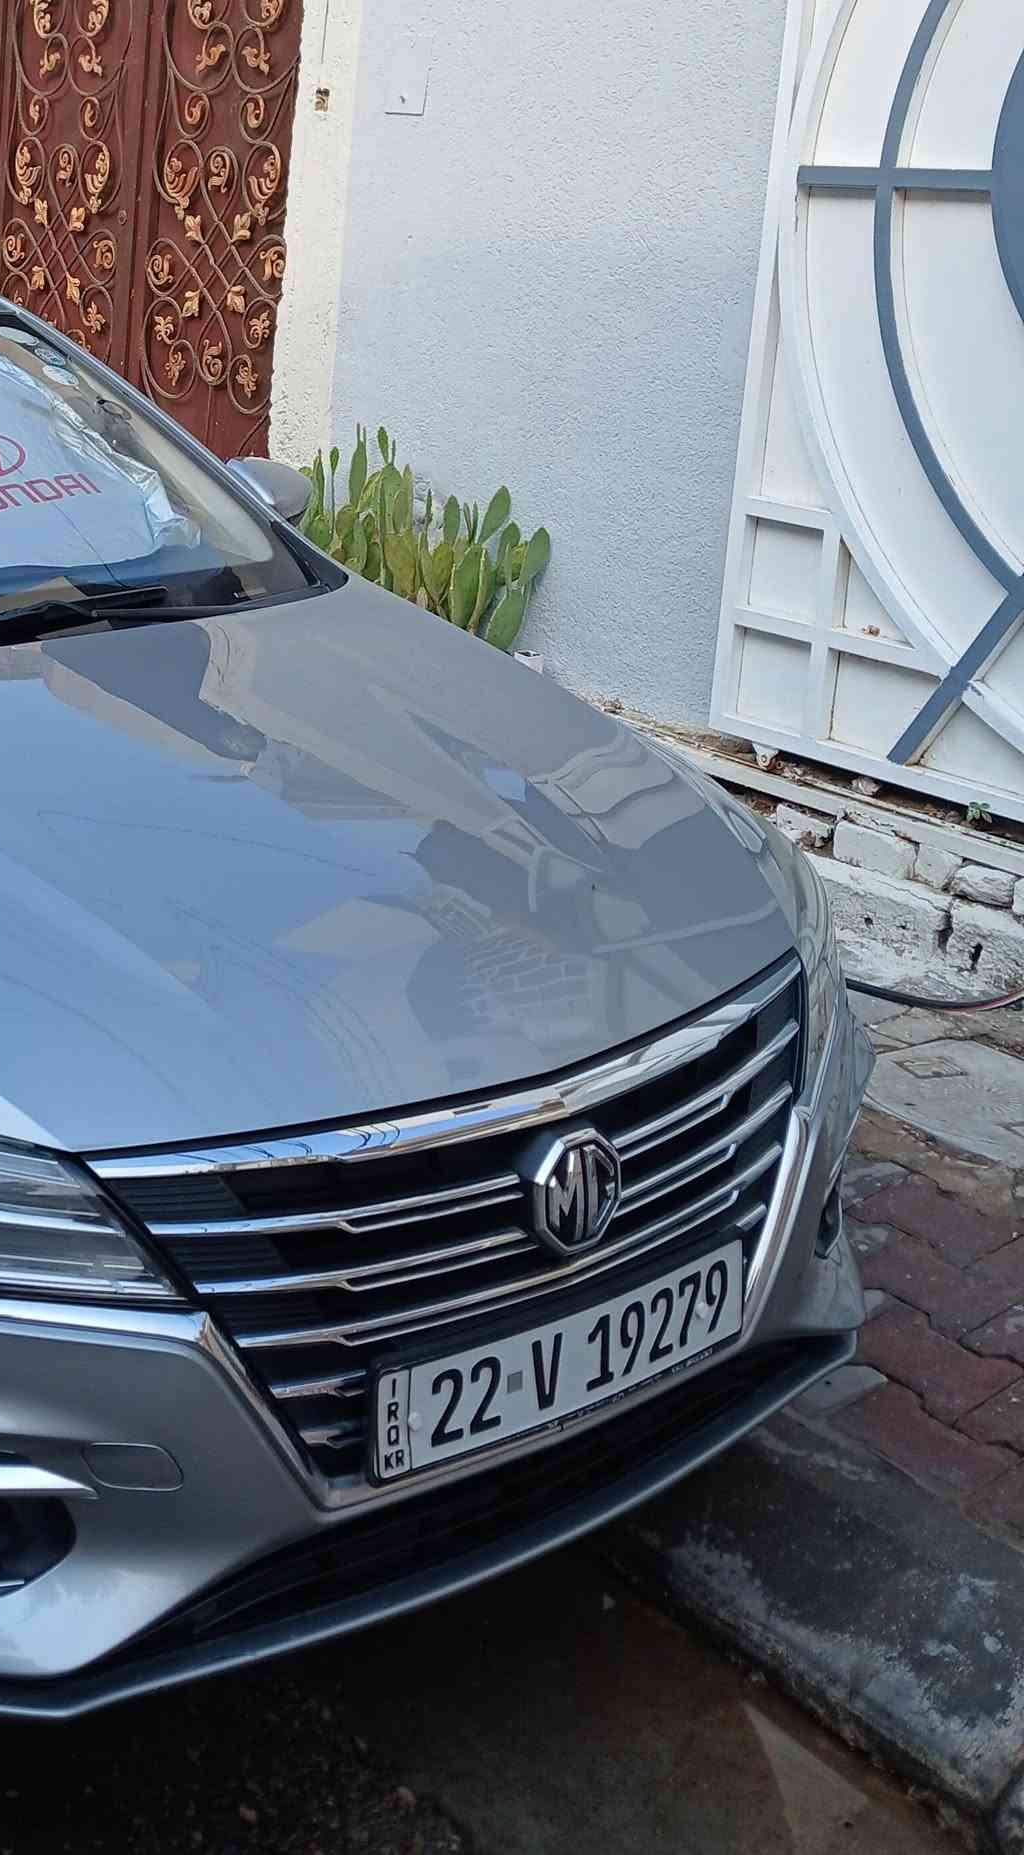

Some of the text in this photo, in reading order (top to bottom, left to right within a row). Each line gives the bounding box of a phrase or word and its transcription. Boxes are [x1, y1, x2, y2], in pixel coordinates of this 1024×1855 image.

[544, 1142, 618, 1240] MG
[430, 1259, 730, 1449] 22 V 19279
